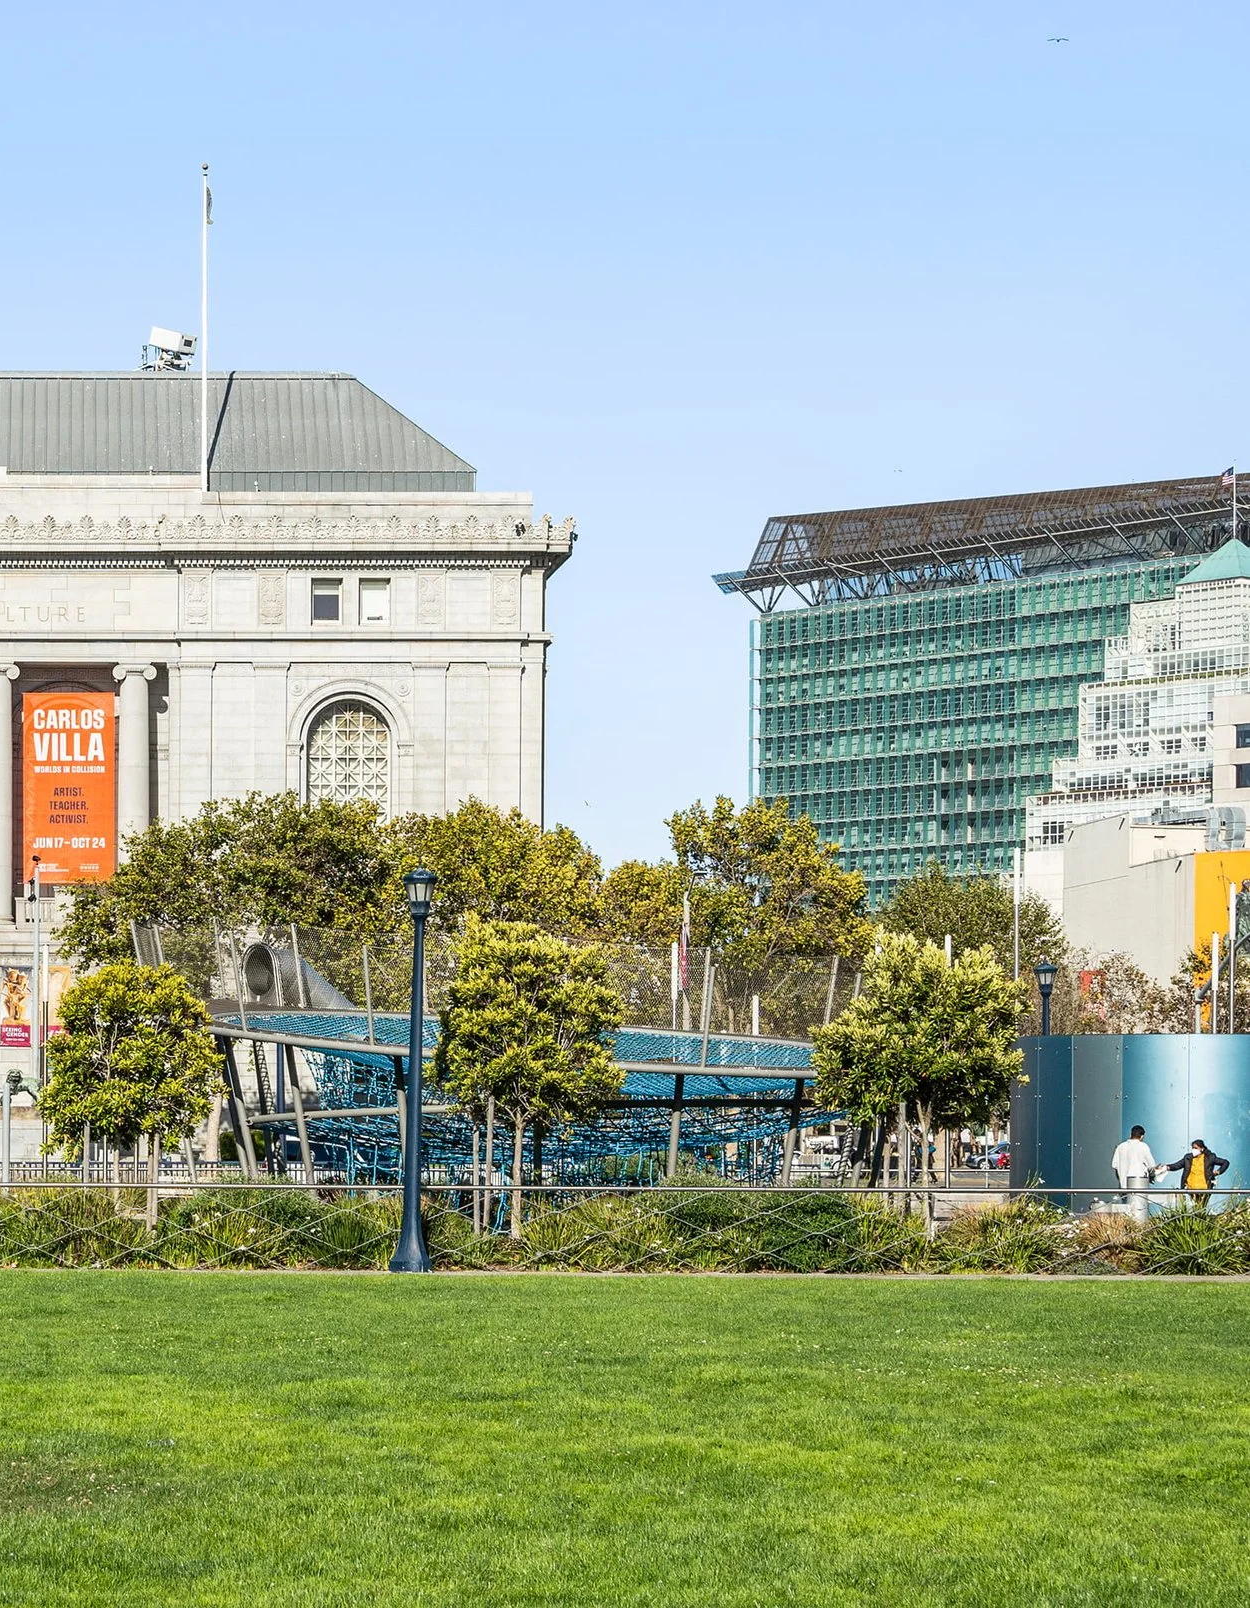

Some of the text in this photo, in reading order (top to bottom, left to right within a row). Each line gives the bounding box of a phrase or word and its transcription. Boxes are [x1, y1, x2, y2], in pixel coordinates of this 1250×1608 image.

[33, 708, 105, 730] CARLOS
[33, 732, 105, 762] VILLA
[33, 765, 105, 774] WORLDS IN COLLISION
[53, 787, 85, 797] ARTIST.
[49, 800, 89, 811] TEACHER.
[49, 814, 88, 824] ACTIVIST.
[33, 837, 53, 849] JUN
[91, 837, 106, 849] 24
